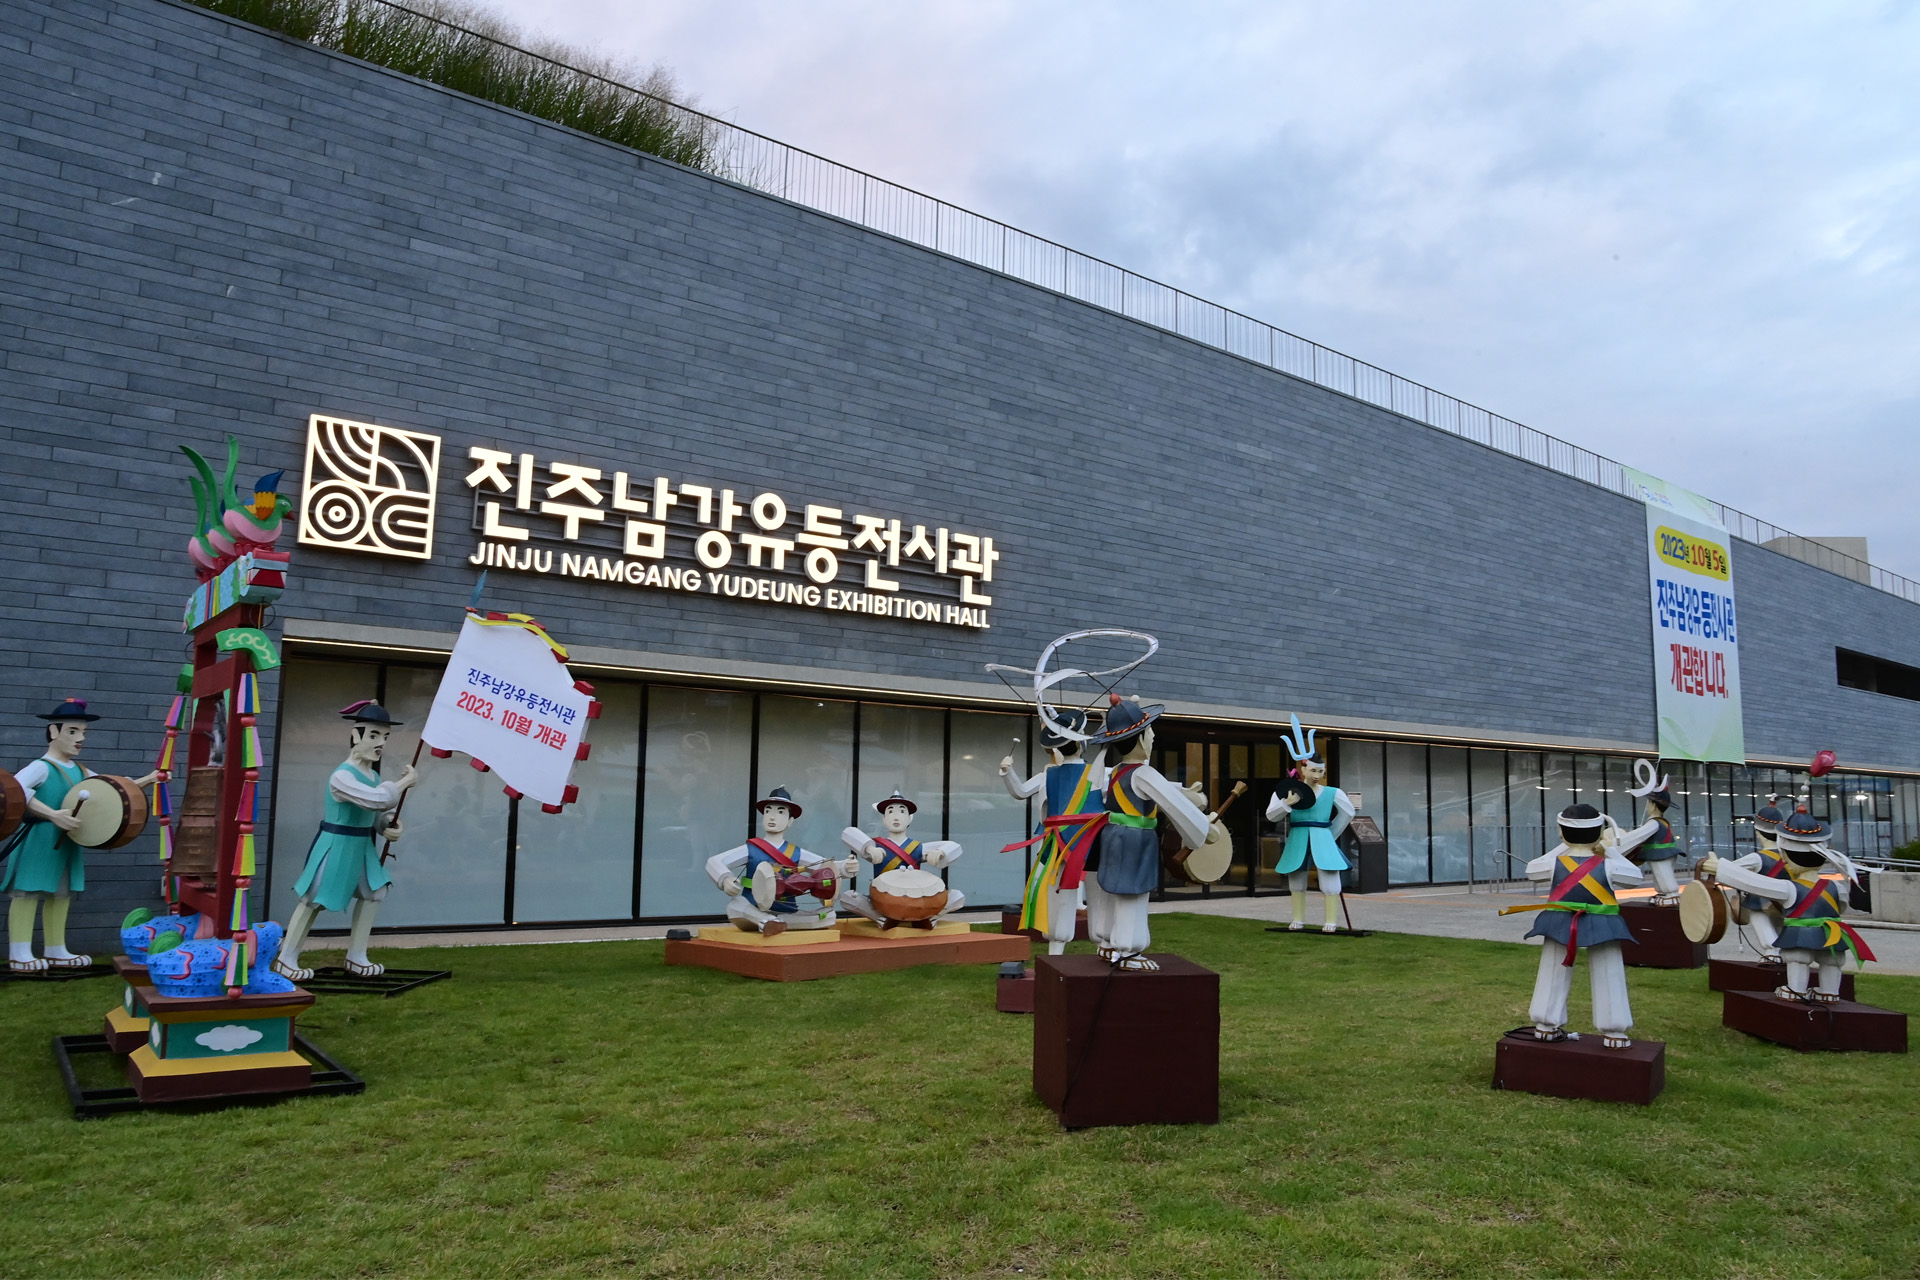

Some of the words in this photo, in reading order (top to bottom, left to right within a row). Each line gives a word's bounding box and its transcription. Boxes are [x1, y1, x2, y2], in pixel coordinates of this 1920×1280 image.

[465, 446, 999, 606] 진주남강유등전시관
[469, 541, 552, 573] JINJU
[560, 552, 702, 592] NAMGANG
[707, 572, 822, 607] YUDEUNG
[824, 588, 941, 623] EXHIBITION
[943, 604, 991, 629] HALL
[1656, 579, 1735, 643] 진주남강유등전시관
[467, 667, 576, 726] 진주남강유등전시관
[1670, 644, 1729, 699] 개관합니다.
[456, 690, 495, 722] 2023.
[500, 709, 534, 737] 10월
[533, 723, 567, 751] 개관
